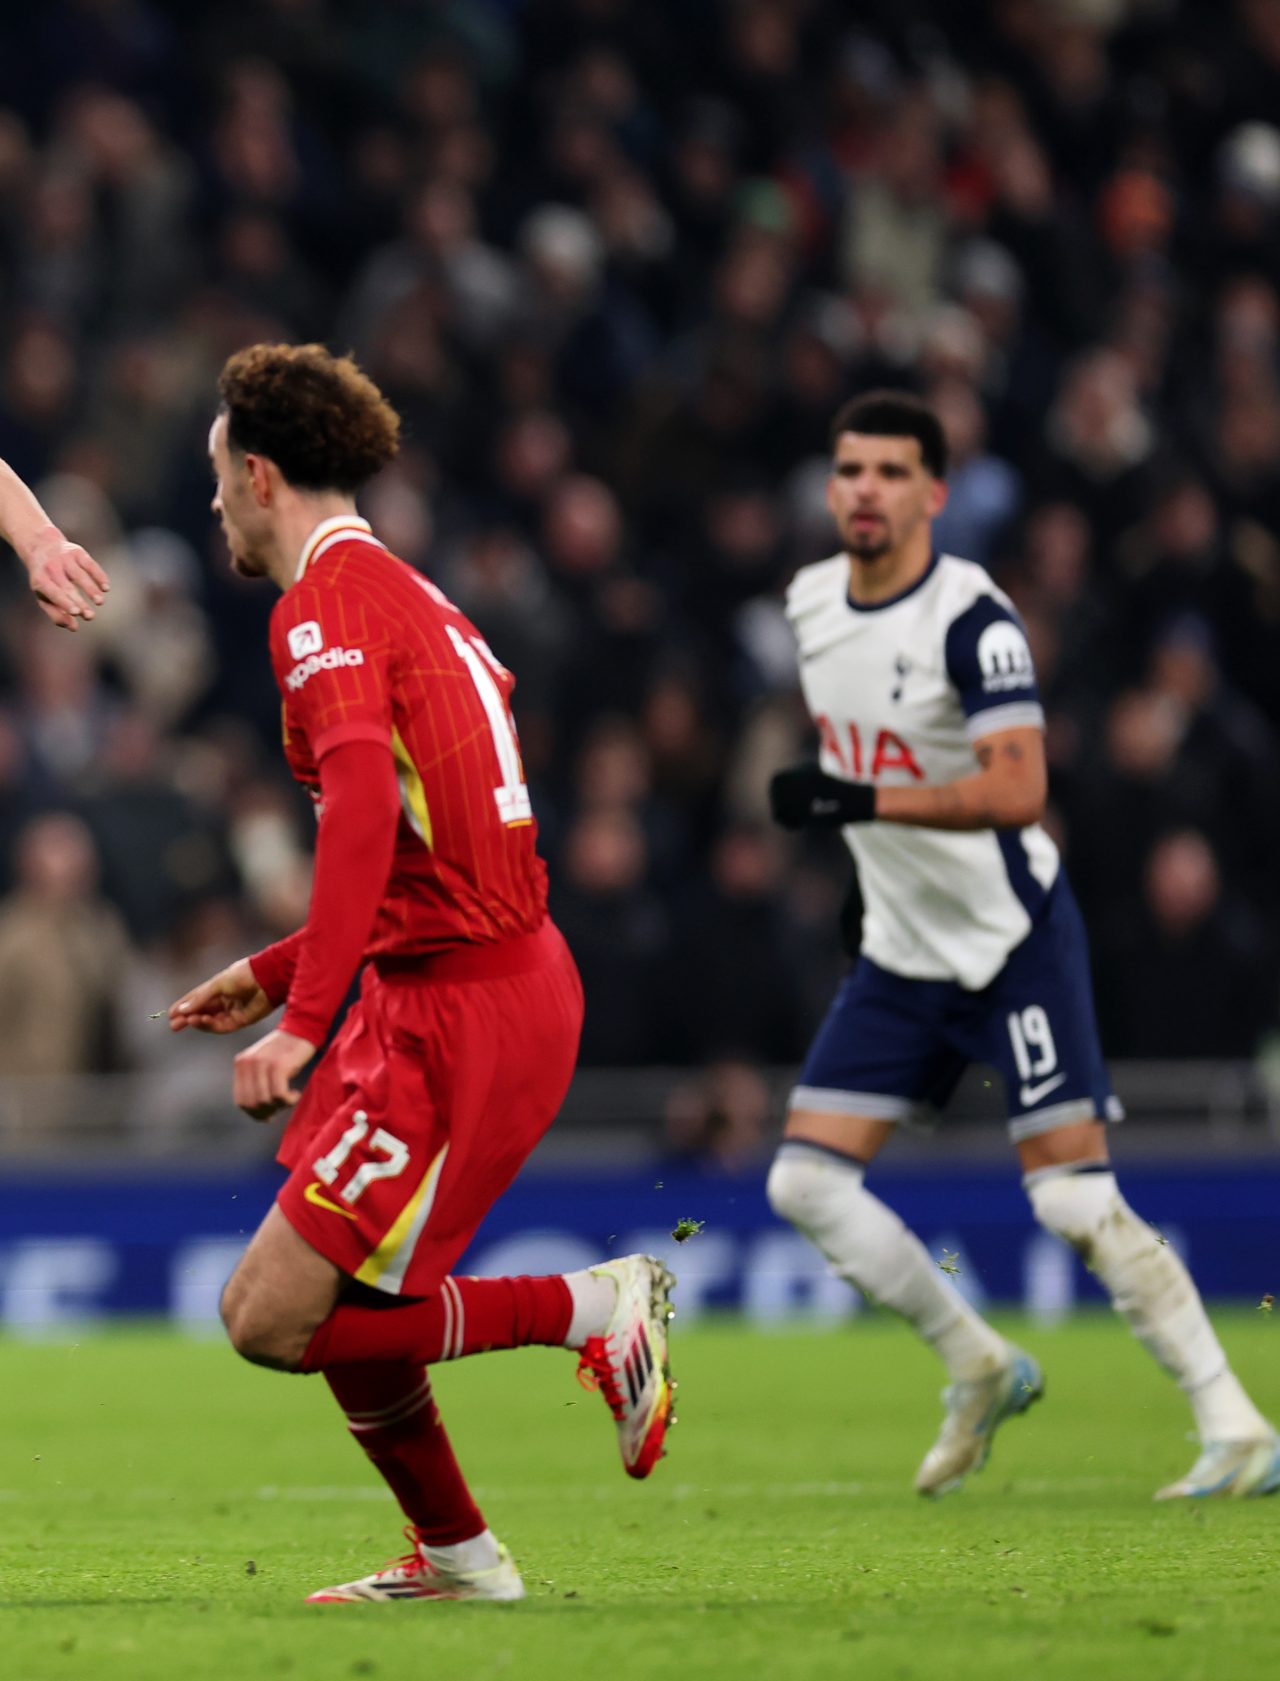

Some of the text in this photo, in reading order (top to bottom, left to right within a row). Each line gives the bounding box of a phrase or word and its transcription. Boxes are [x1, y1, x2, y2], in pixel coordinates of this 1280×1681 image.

[445, 624, 533, 823] 1
[1007, 1004, 1057, 1081] 19
[312, 1109, 410, 1206] 17
